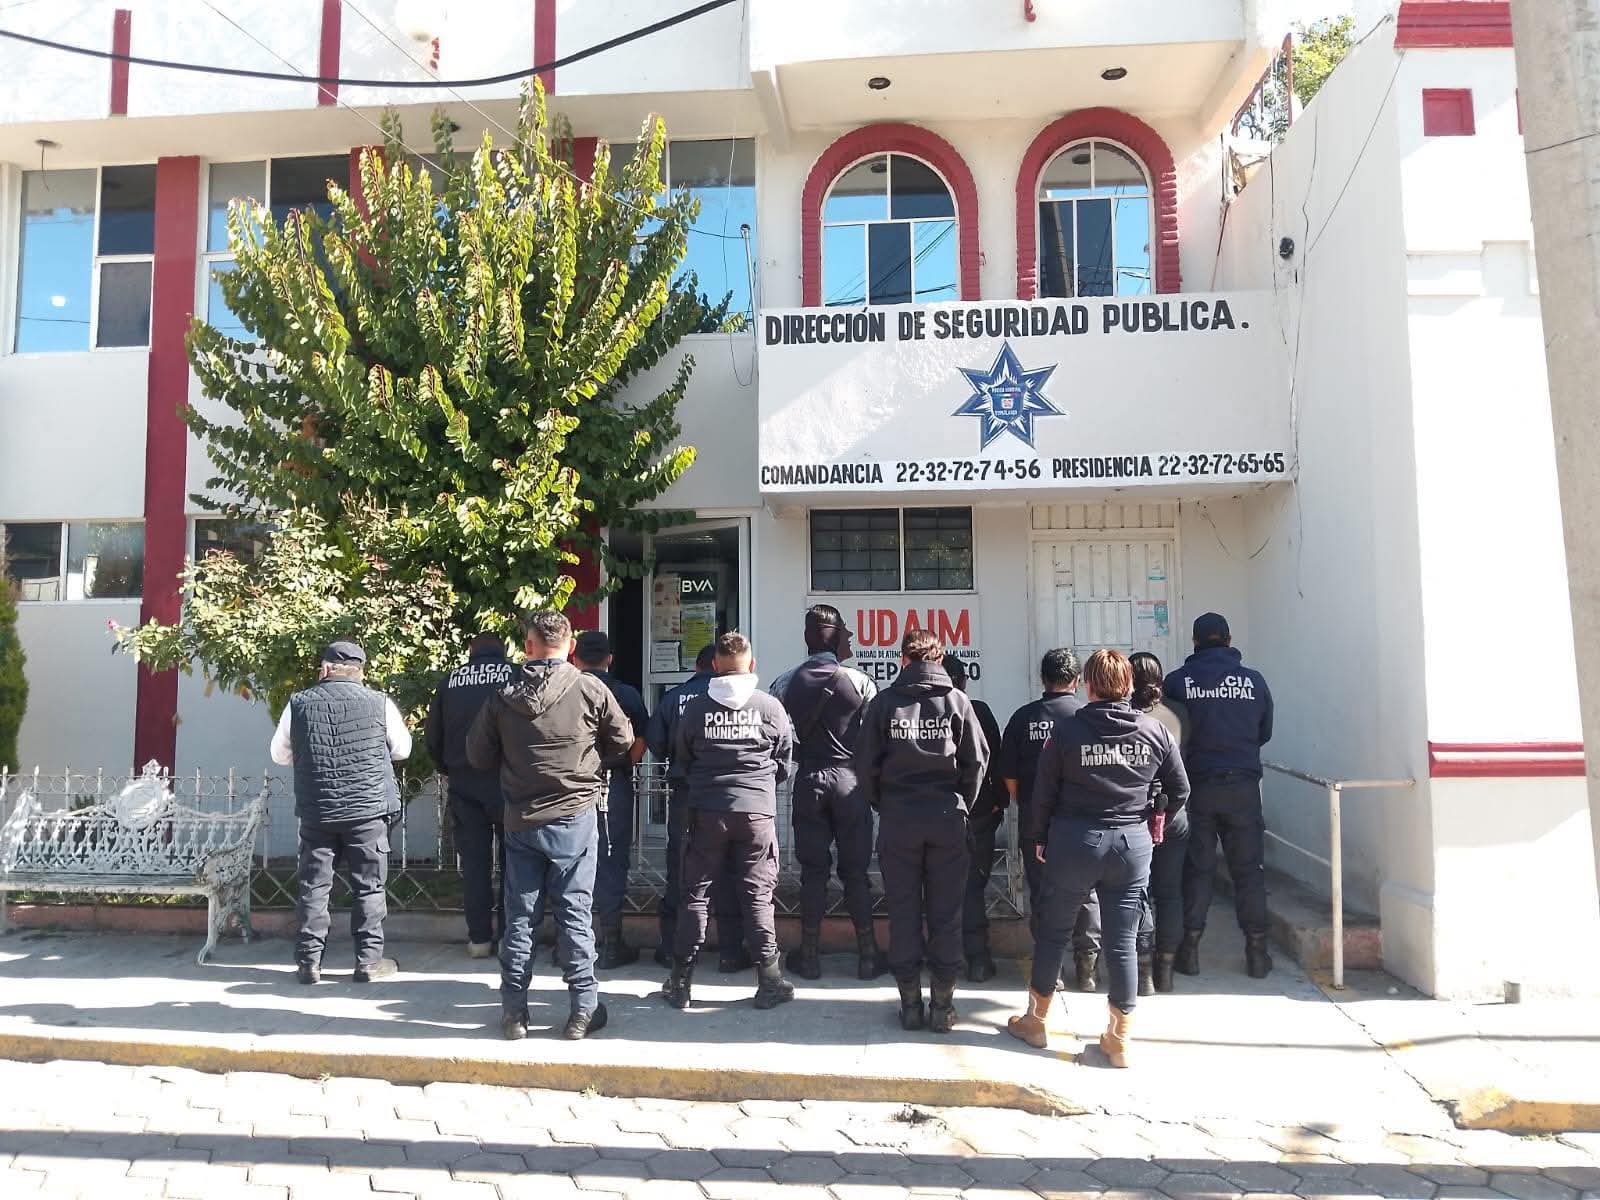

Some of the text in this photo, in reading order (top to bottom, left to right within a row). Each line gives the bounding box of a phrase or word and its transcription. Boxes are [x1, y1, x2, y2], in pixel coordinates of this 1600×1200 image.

[766, 300, 1250, 345] DIRECCIÓN DE SEGURIDAD PUBLICA.
[761, 463, 883, 485] COMANDANCIA
[1052, 456, 1152, 479] PRESIDENCIA
[681, 579, 713, 593] BVA
[857, 608, 970, 647] UDAIM
[1185, 686, 1256, 700] MUNICIPAL
[704, 725, 762, 740] MUNICIPAL
[890, 728, 950, 740] MUNICIPAL
[1080, 753, 1151, 767] MUNICIPAL
